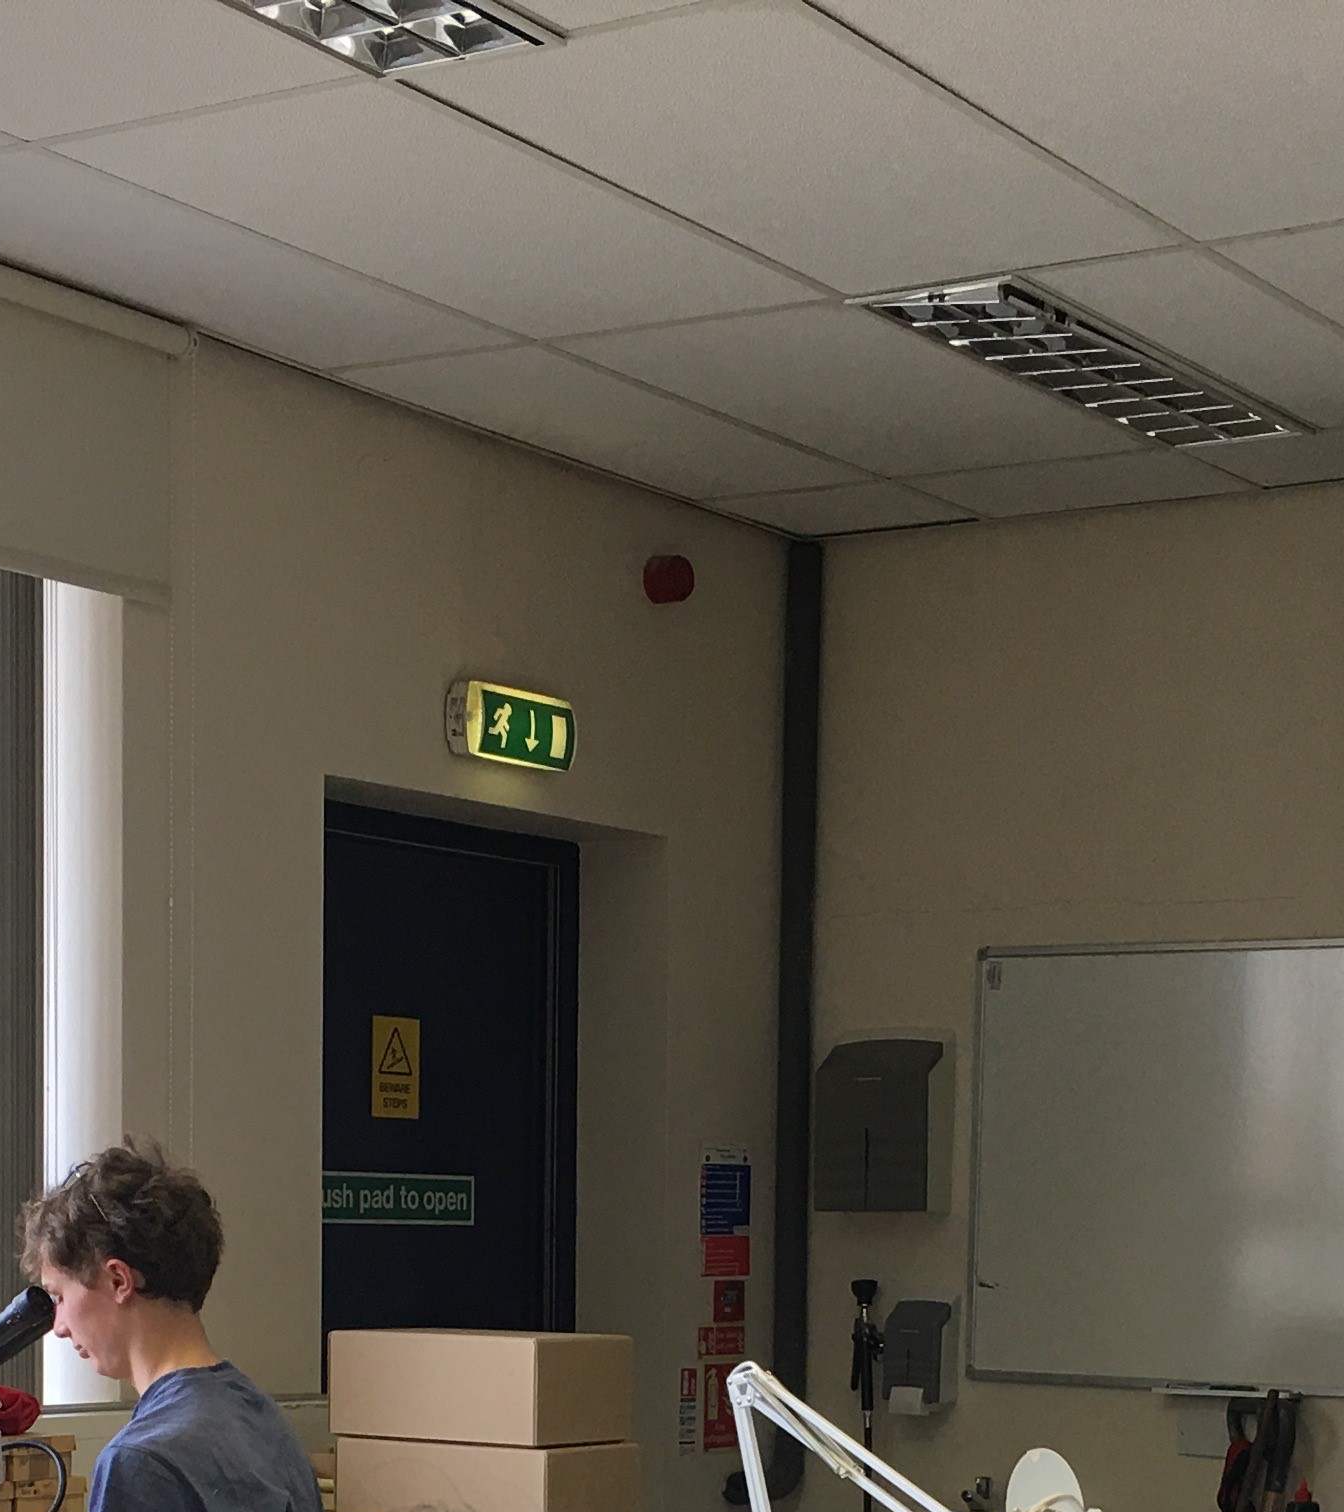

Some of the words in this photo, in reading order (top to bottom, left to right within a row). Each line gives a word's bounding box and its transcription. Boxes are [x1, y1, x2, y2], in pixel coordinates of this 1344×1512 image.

[379, 1081, 411, 1094] BEWARE
[383, 1097, 408, 1110] STEPS
[322, 1182, 354, 1209] ush
[359, 1184, 395, 1214] pad
[399, 1185, 420, 1210] to
[423, 1190, 468, 1215] open
